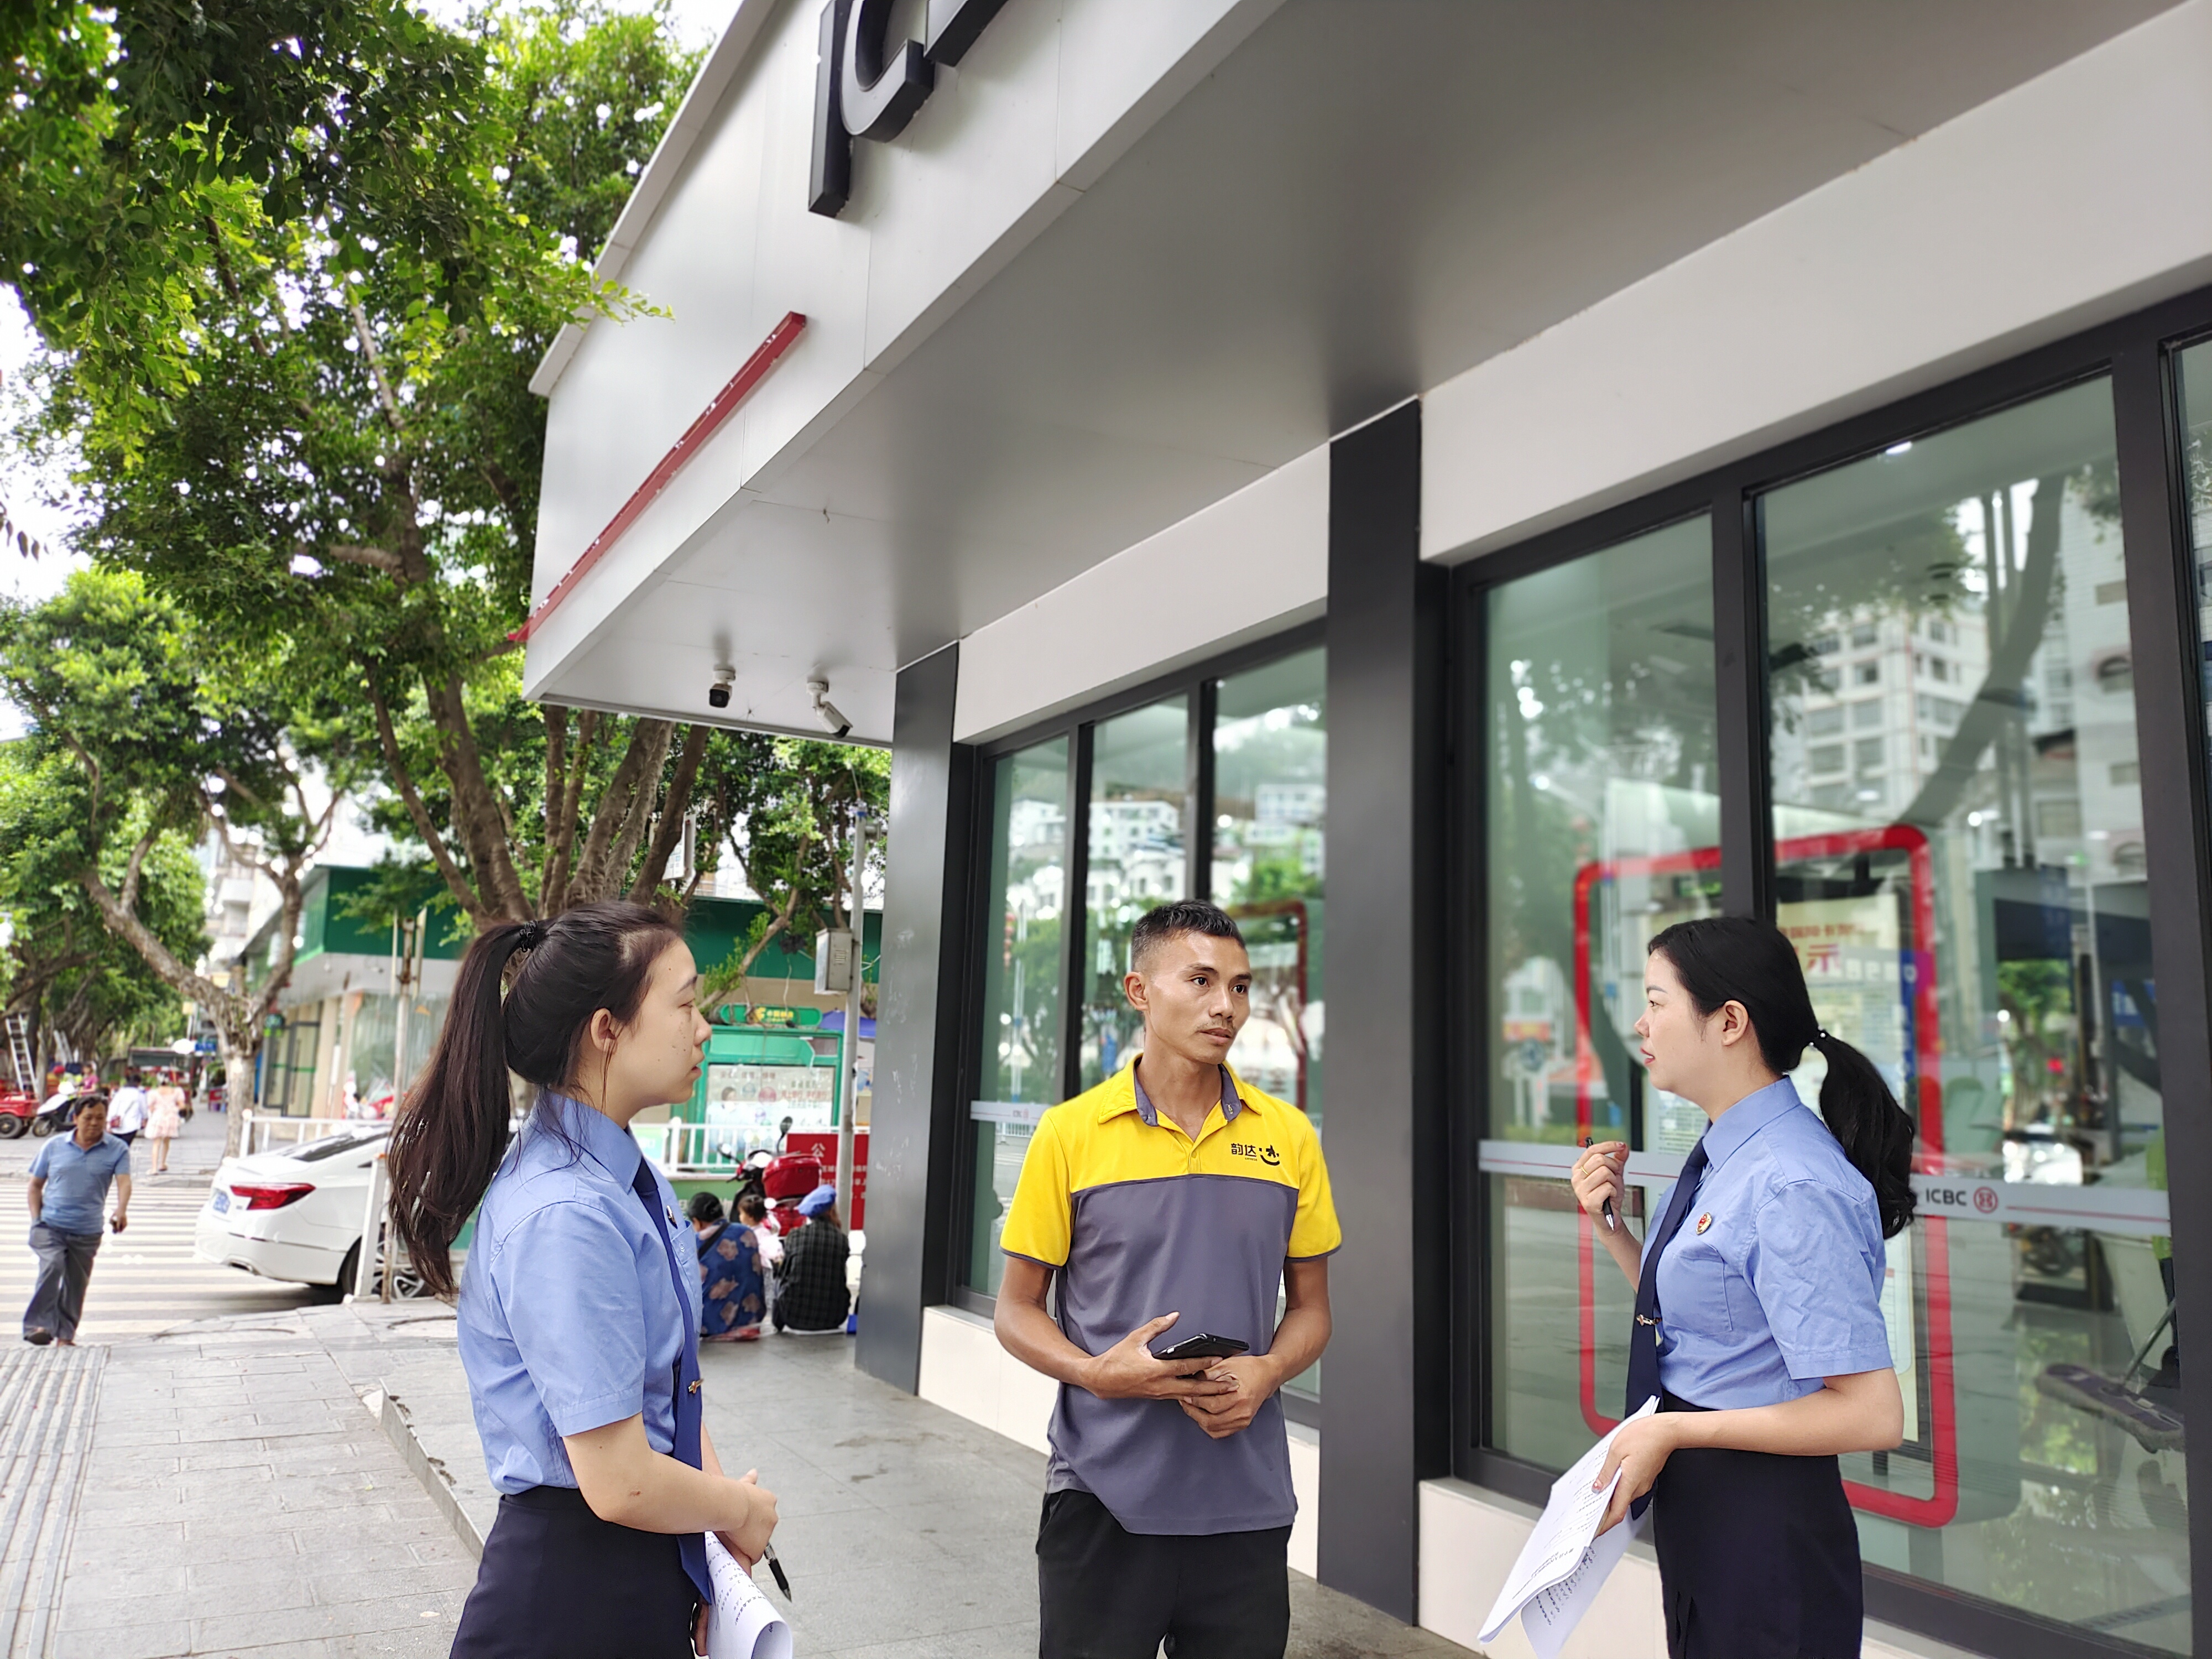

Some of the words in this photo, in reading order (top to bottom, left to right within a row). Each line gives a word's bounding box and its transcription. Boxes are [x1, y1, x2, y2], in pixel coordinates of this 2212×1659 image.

[811, 1142, 826, 1158] 公
[1230, 1142, 1257, 1157] 韵达
[1926, 1188, 1967, 1206] ICBC
